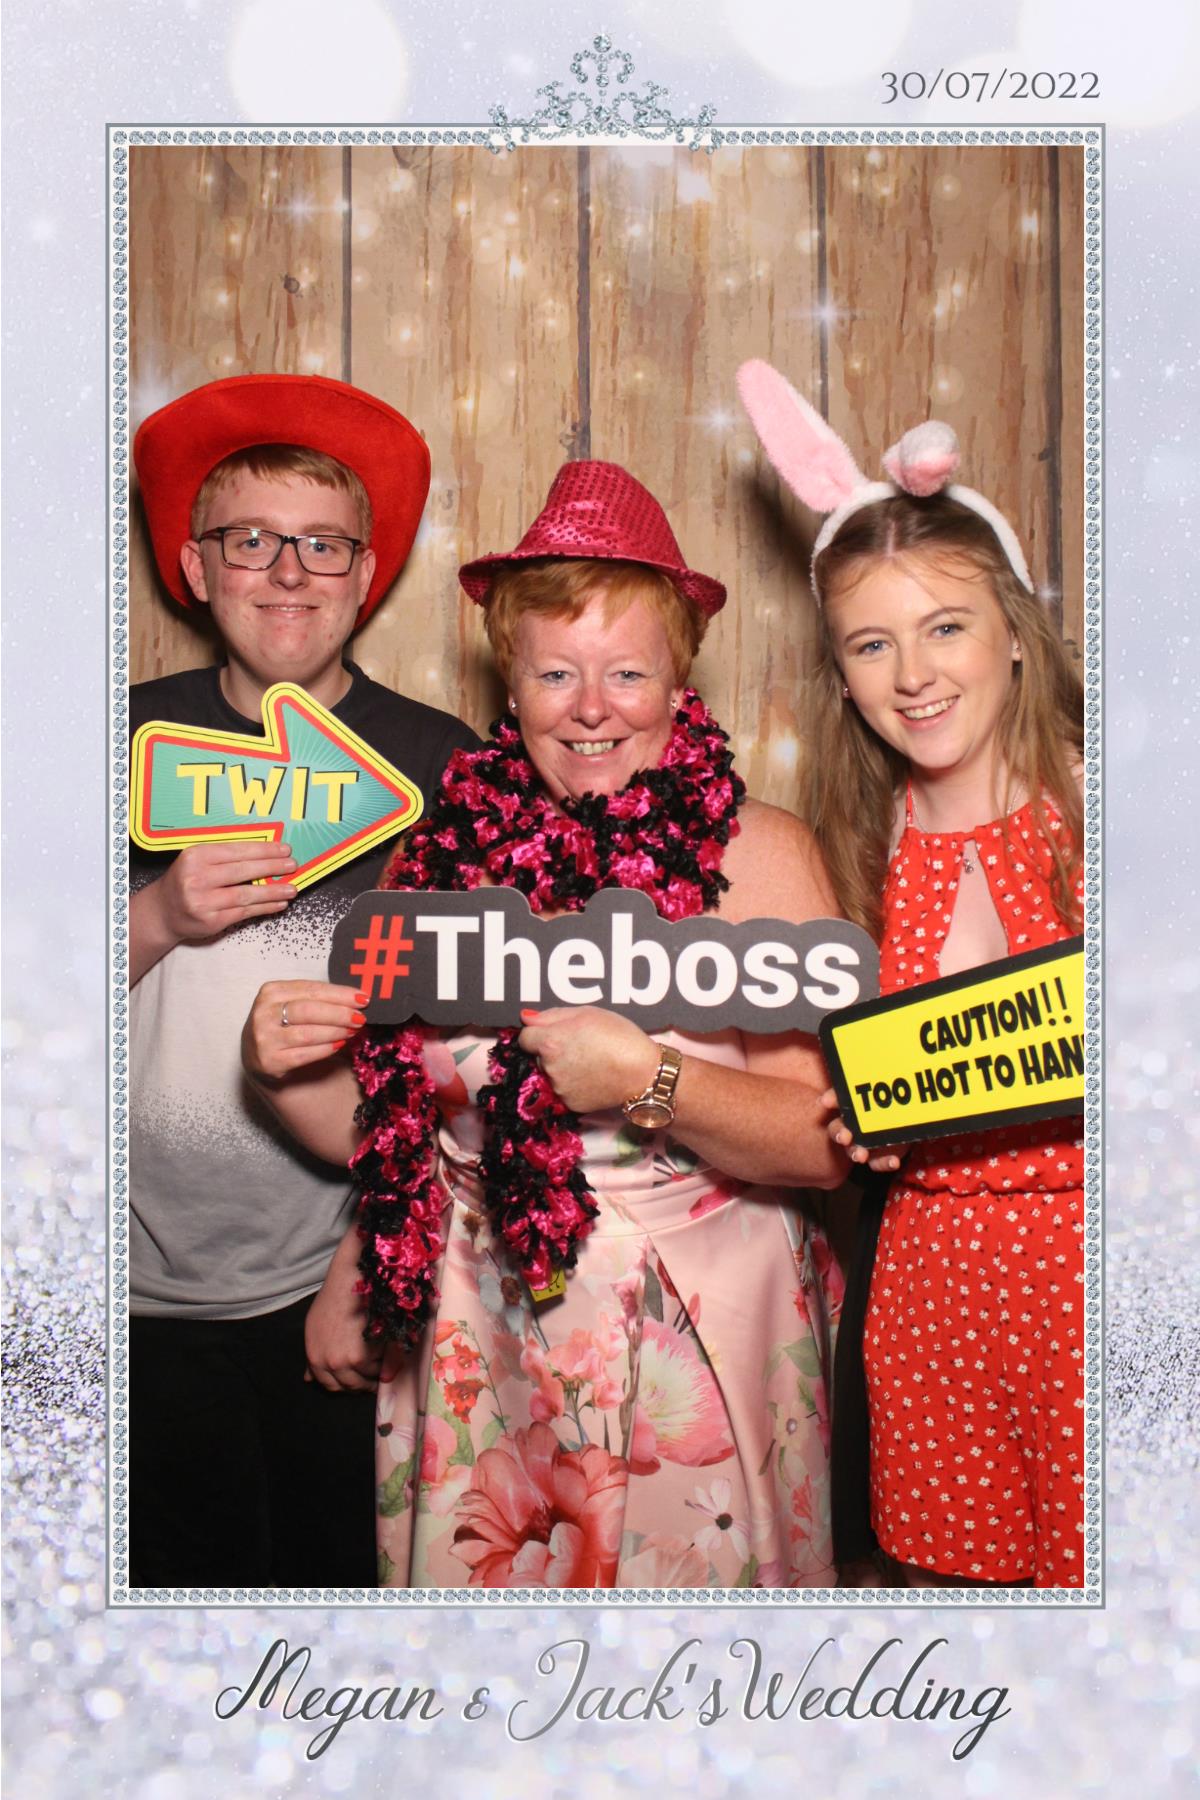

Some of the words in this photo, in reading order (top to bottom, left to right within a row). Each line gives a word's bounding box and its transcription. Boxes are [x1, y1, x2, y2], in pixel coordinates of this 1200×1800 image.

[176, 761, 360, 824] TWIT
[349, 910, 862, 1010] #Theboss
[919, 976, 1073, 1055] CAUTION!!
[855, 1077, 912, 1113] TOO
[915, 1060, 971, 1104] HOT
[974, 1053, 1016, 1092] TO
[1018, 1033, 1084, 1086] HAN
